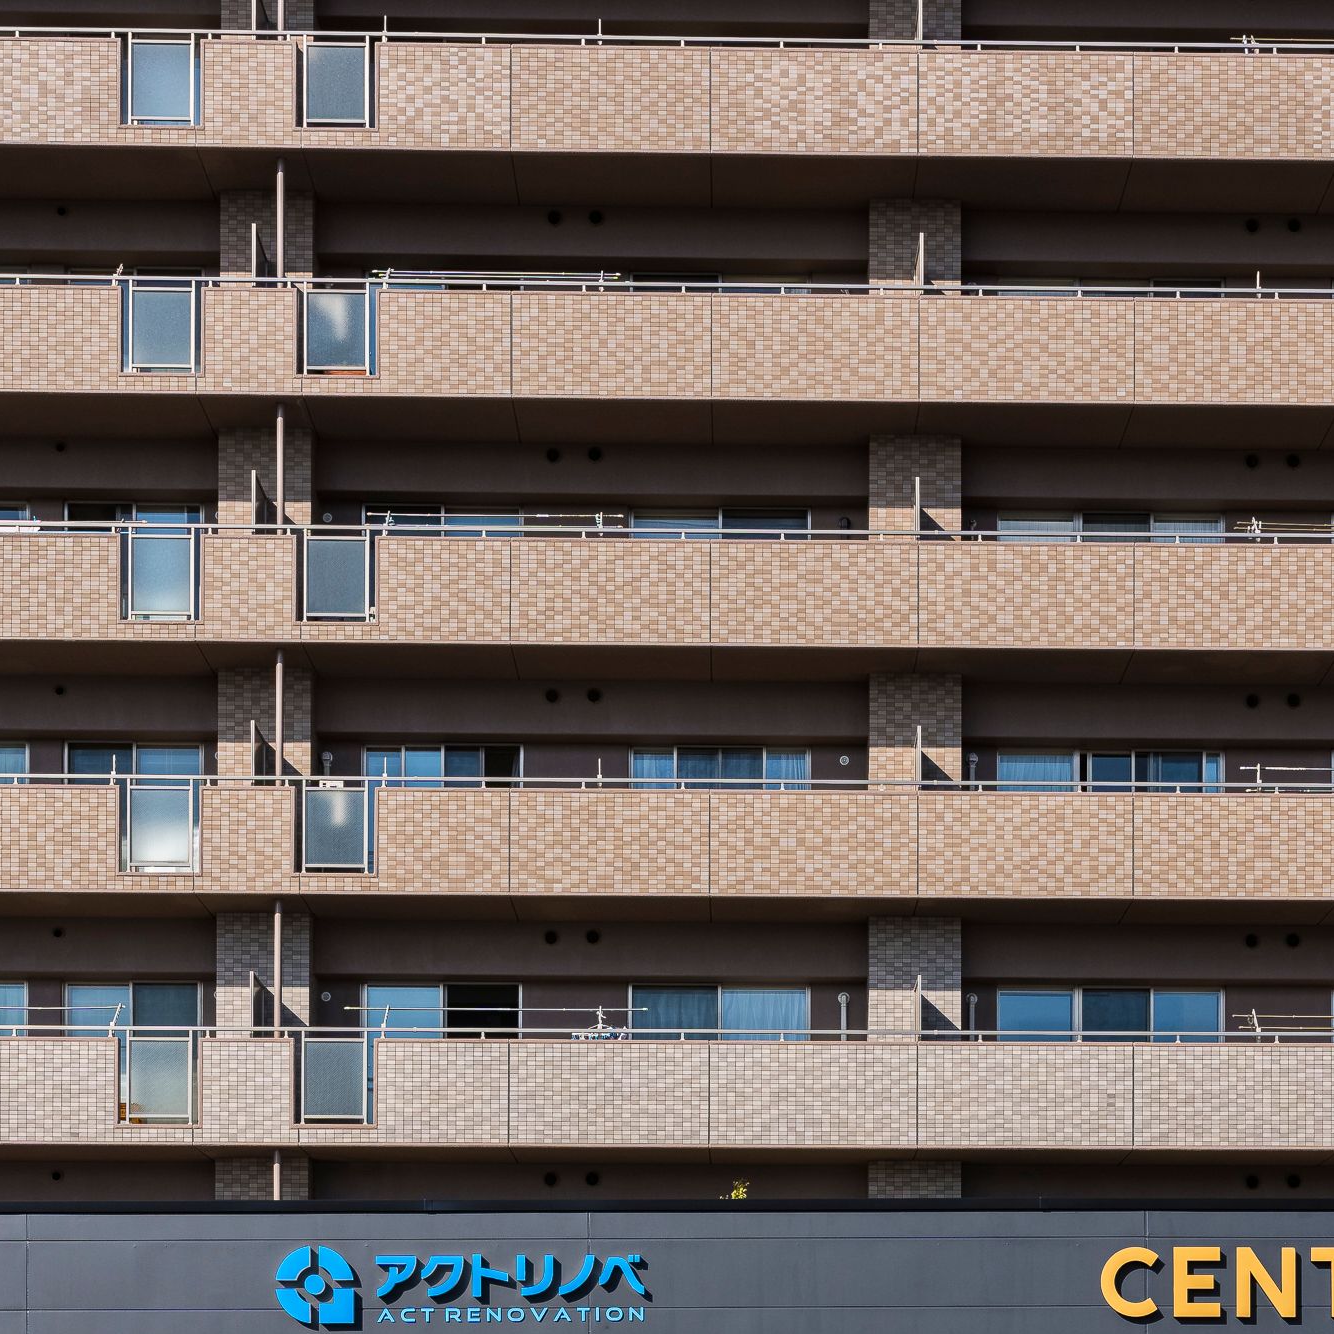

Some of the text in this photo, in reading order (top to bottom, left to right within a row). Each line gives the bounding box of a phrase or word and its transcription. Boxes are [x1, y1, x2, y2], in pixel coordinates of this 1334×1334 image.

[375, 1253, 646, 1298] アクトリノベ
[377, 1305, 647, 1323] ACT RENOVATION
